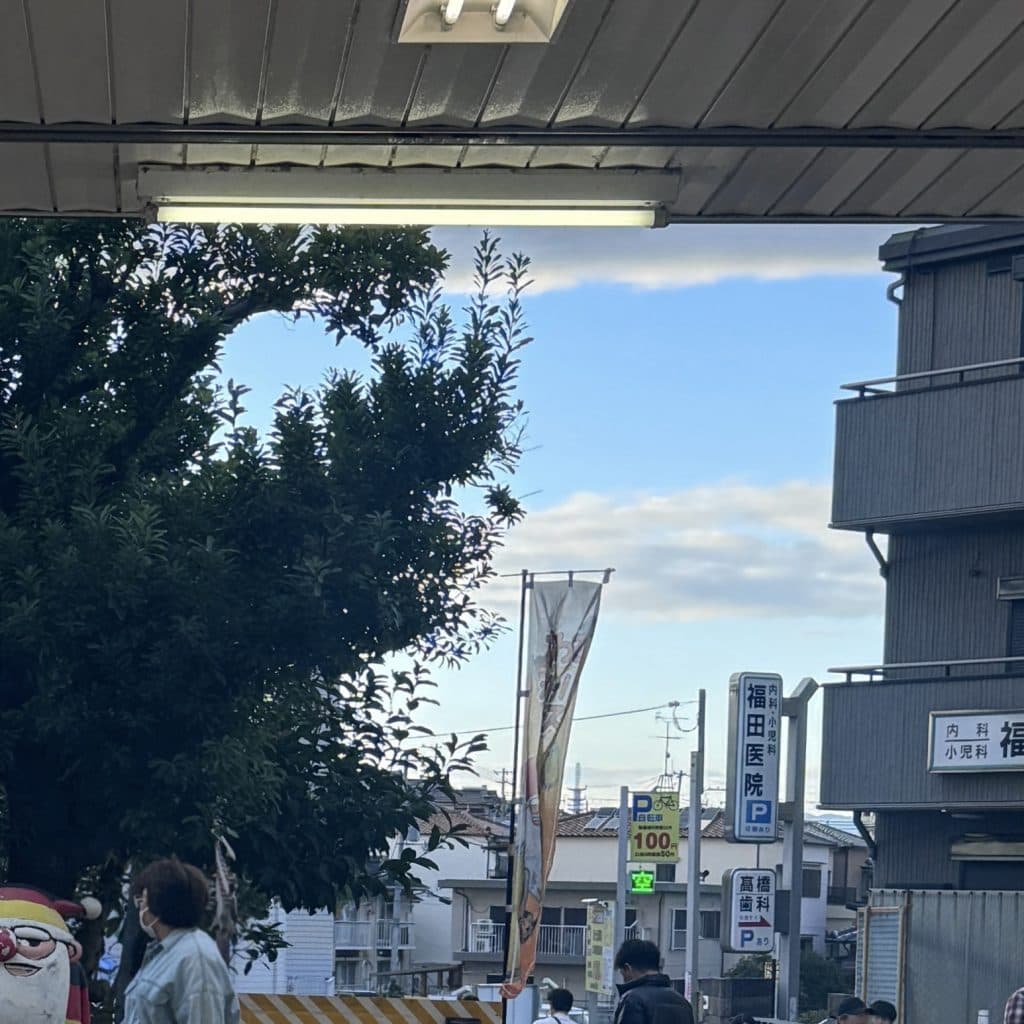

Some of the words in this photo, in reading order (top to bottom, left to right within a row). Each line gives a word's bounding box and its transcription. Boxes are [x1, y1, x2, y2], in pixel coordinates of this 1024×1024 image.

[744, 683, 766, 797] 福田医院
[945, 744, 988, 760] 小児科
[752, 804, 767, 821] P
[634, 832, 677, 850] 100円
[739, 896, 770, 912] 歯科
[741, 929, 754, 948] P
